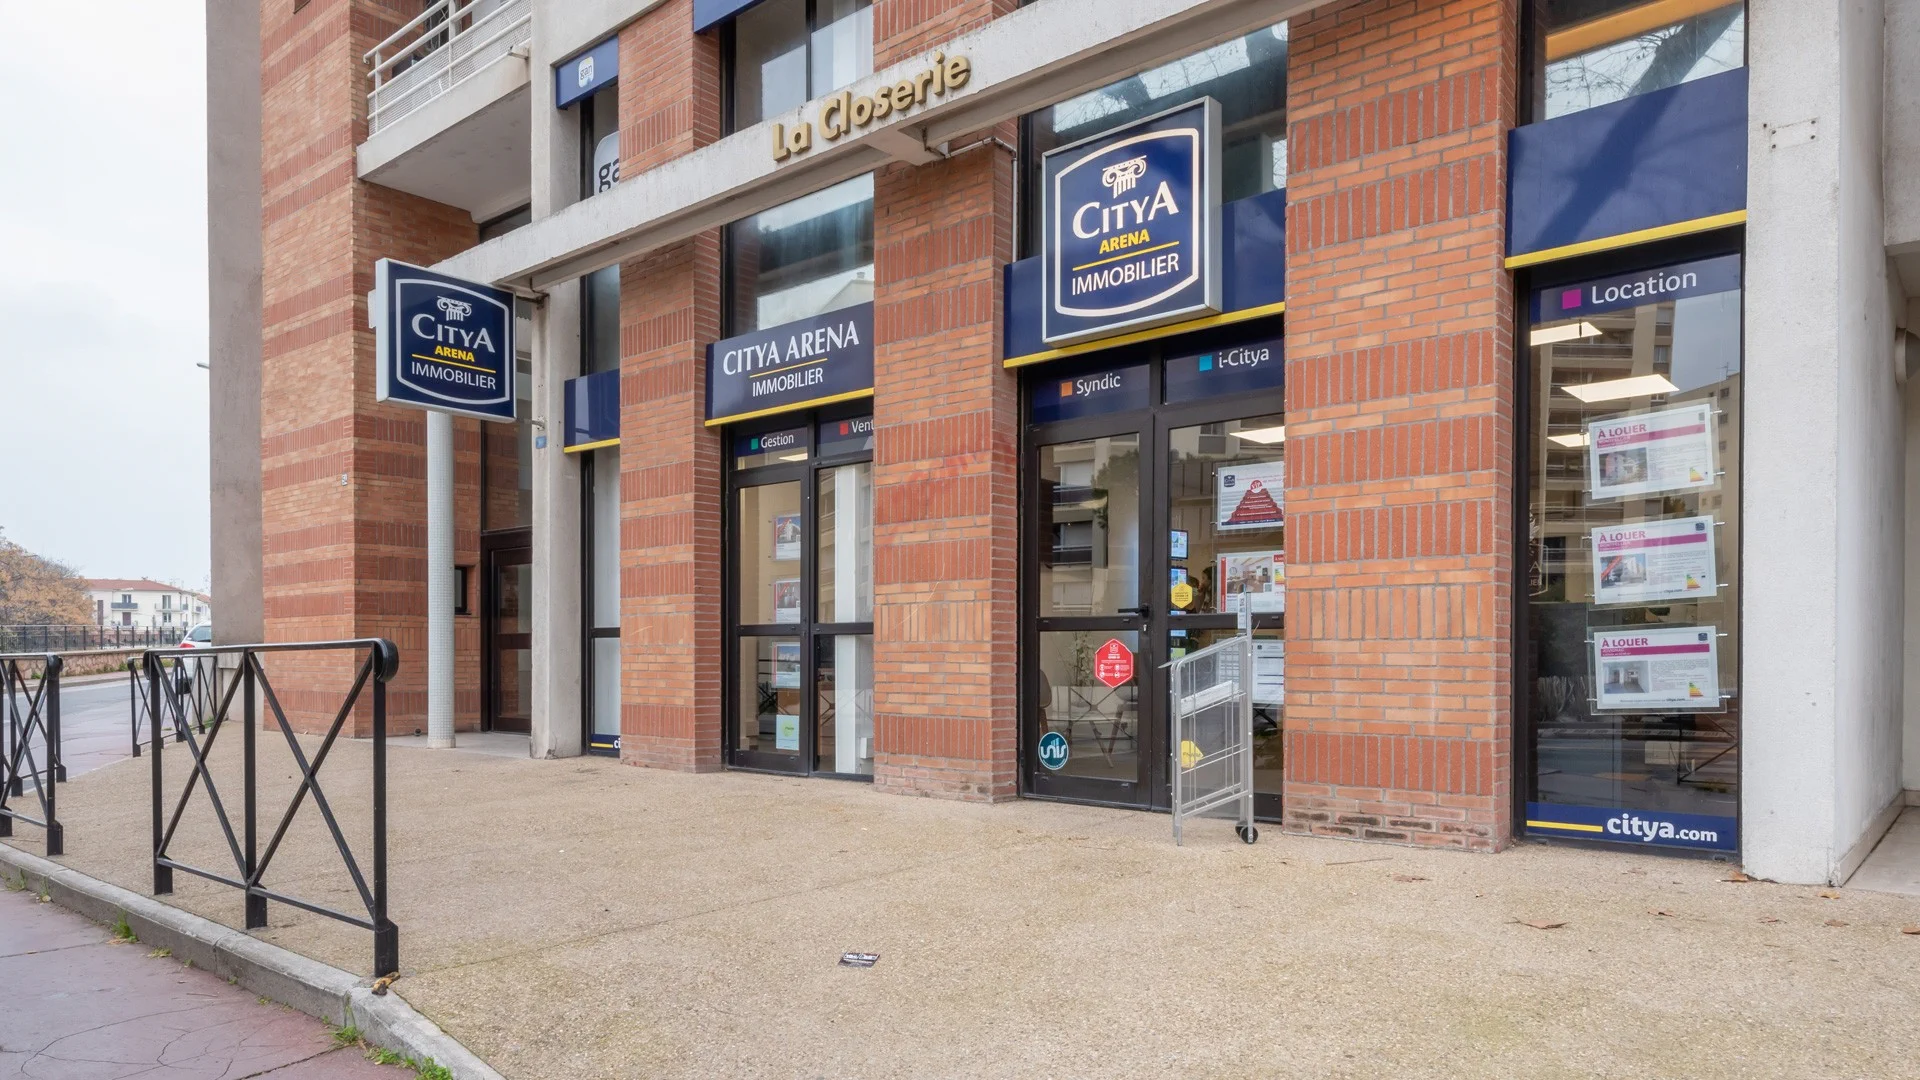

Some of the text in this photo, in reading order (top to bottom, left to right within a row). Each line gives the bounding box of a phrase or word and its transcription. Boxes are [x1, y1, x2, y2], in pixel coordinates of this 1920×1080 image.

[773, 51, 971, 162] La Closerie
[1099, 229, 1150, 255] ARENA
[1072, 253, 1180, 296] IMMOBILIER
[1592, 272, 1697, 304] Location
[435, 345, 475, 362] ARENA
[723, 320, 860, 376] CITYA ARENA
[1218, 348, 1270, 370] i-Citya
[411, 361, 496, 390] IMMOBILIER
[753, 367, 824, 397] IMMOBILIER
[1076, 373, 1121, 397] Syndic
[760, 433, 795, 449] Gestion
[1598, 424, 1647, 439] À LOUER
[1600, 531, 1646, 542] À LOUER
[1602, 637, 1649, 647] À LOUER
[1607, 813, 1718, 842] citya.com
